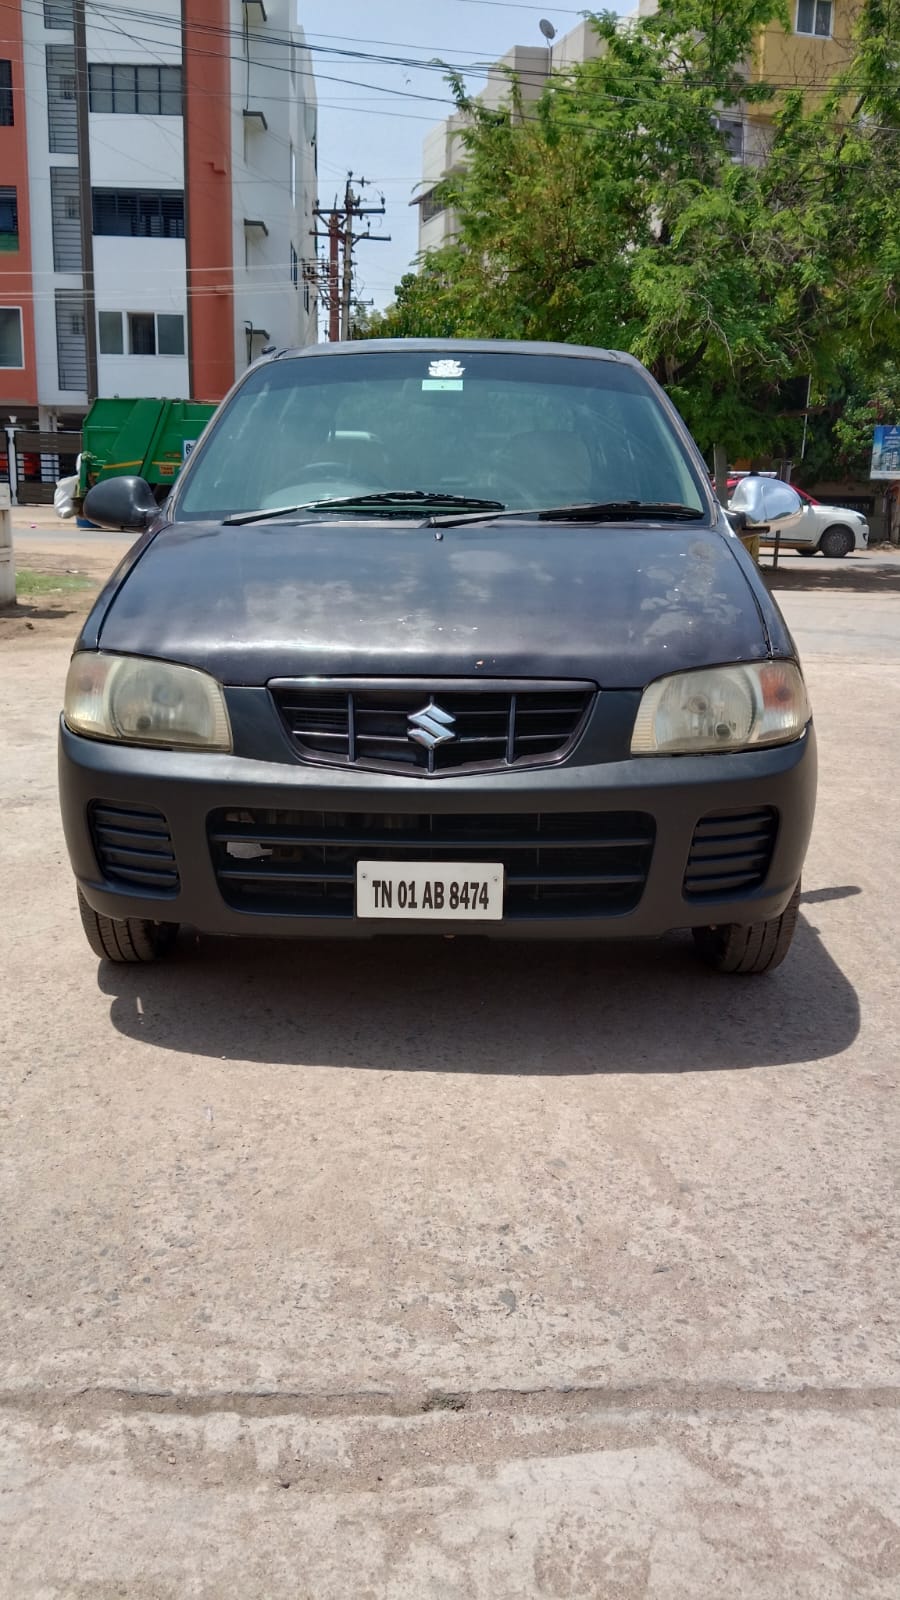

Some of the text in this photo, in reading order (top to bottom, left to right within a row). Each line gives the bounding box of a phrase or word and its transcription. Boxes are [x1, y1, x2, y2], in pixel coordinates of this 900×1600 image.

[372, 880, 490, 910] TN 01 AB 8474
